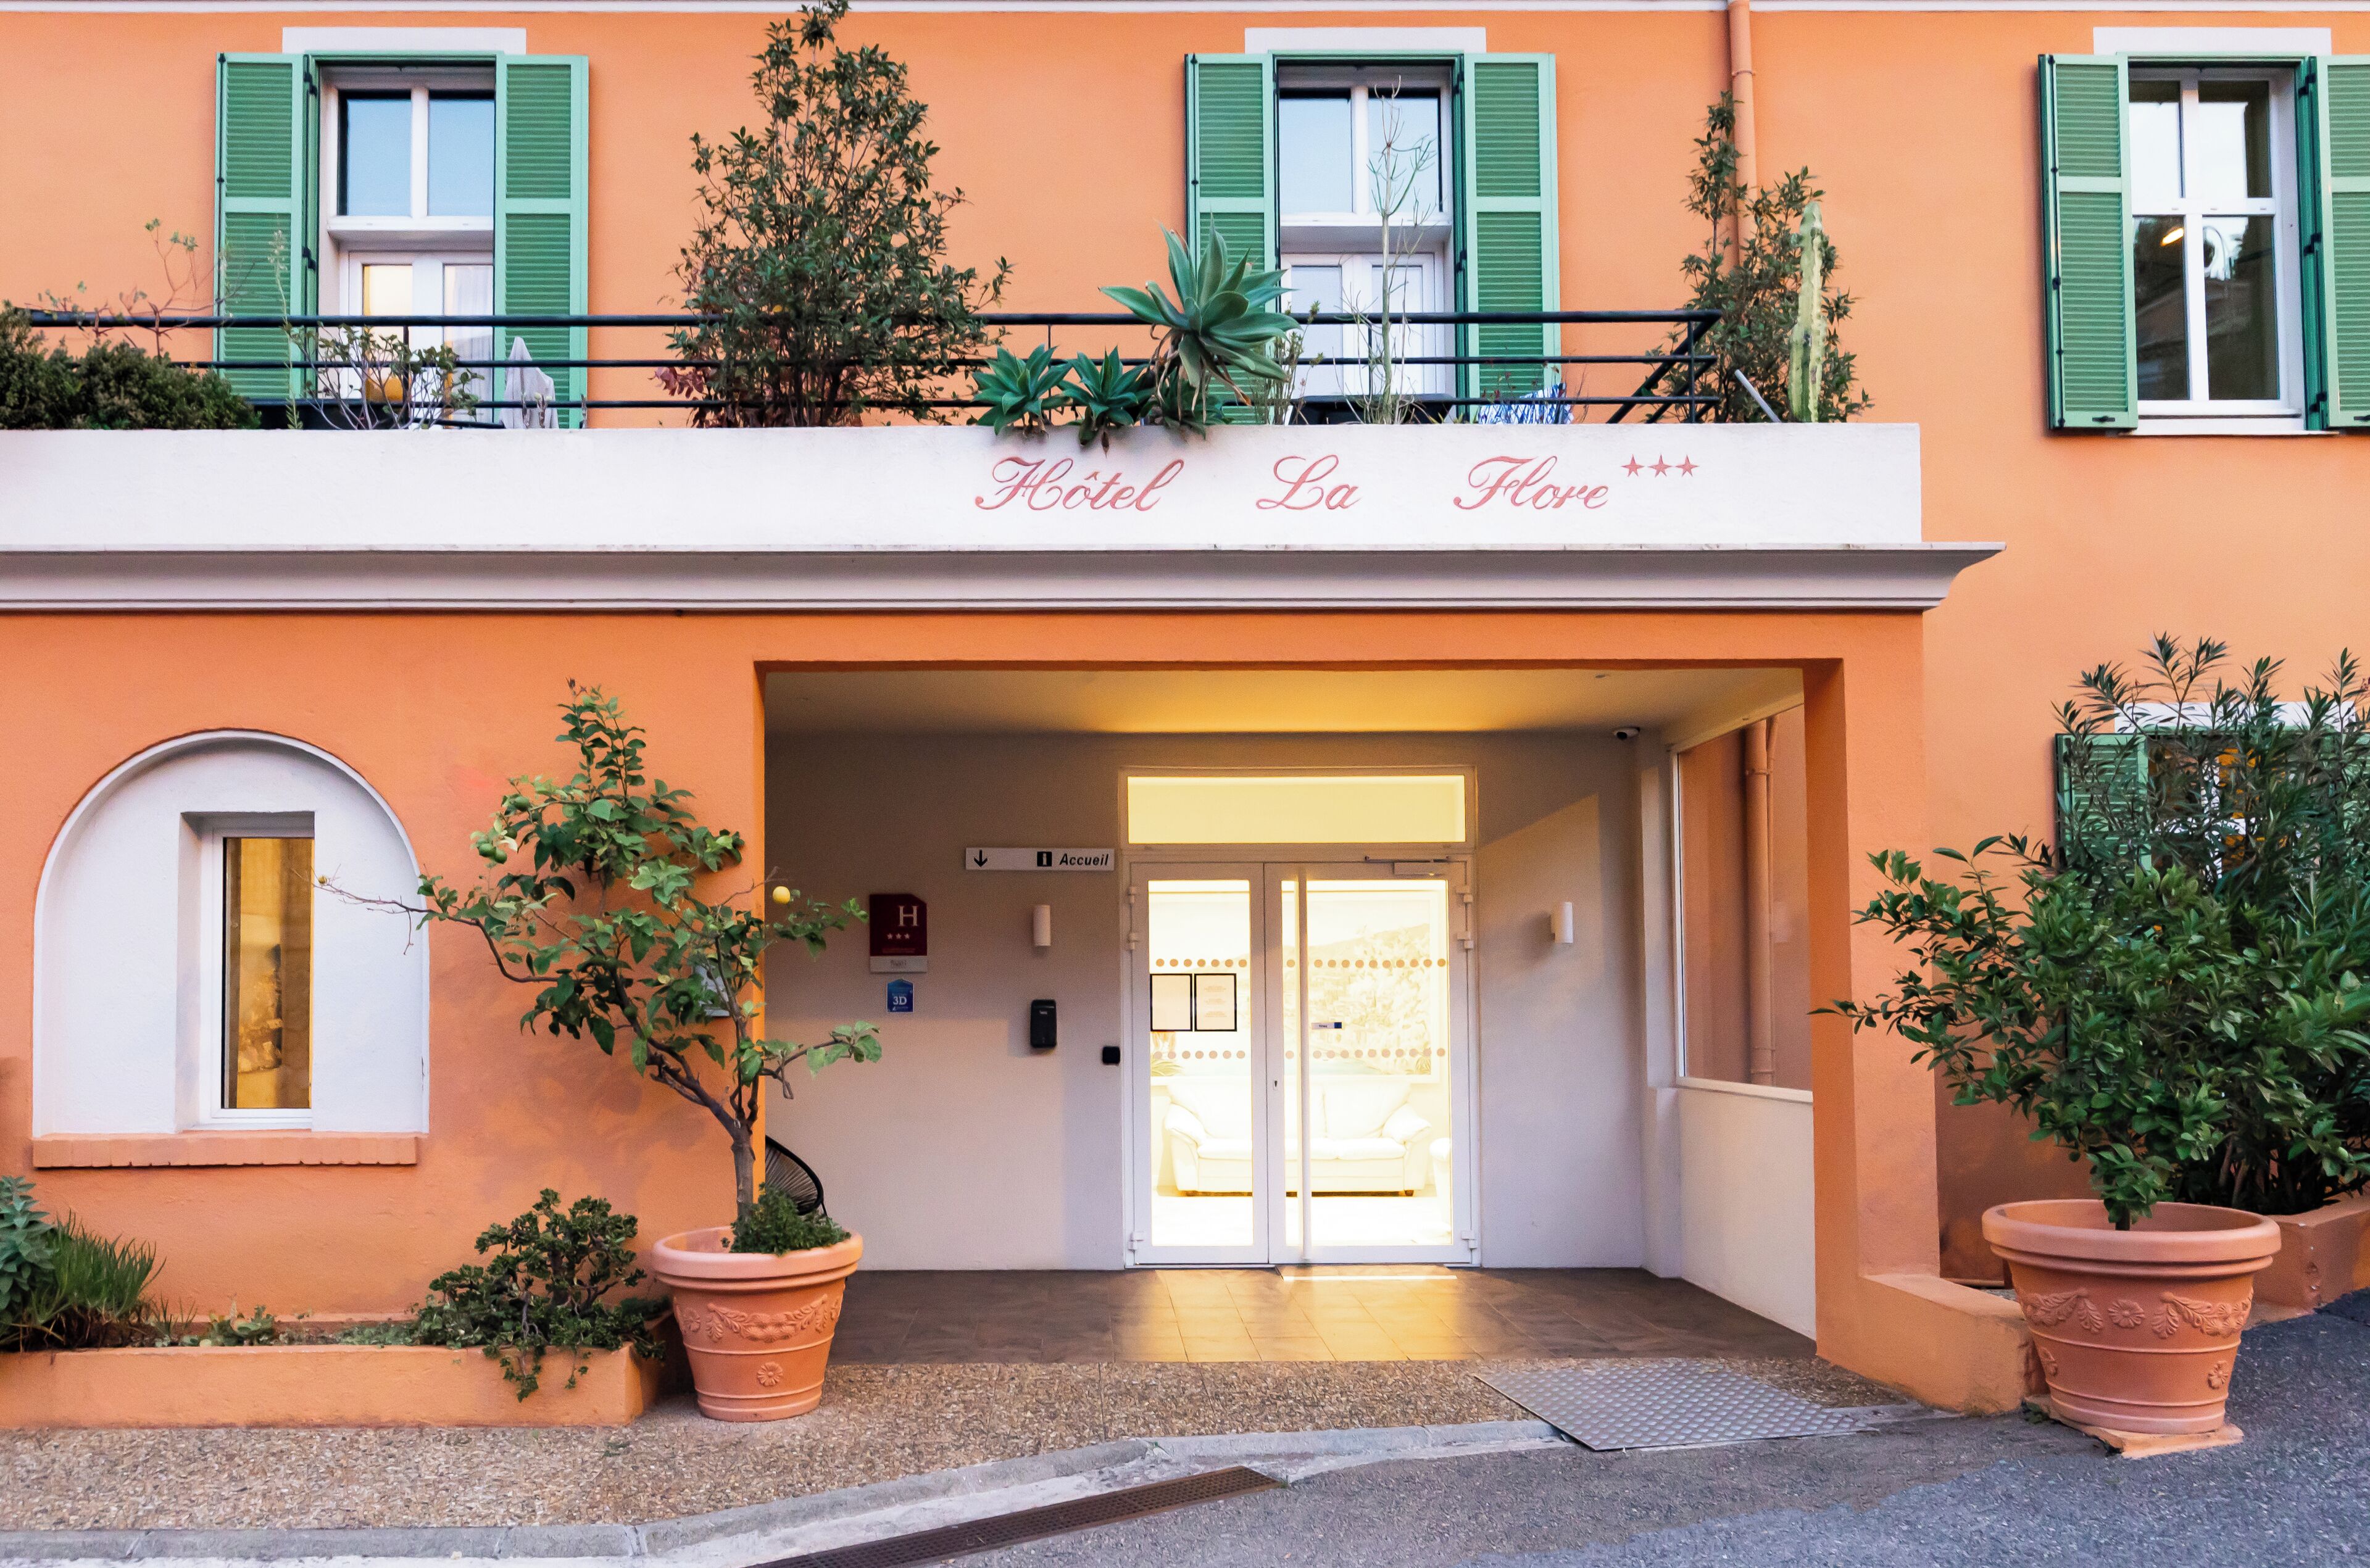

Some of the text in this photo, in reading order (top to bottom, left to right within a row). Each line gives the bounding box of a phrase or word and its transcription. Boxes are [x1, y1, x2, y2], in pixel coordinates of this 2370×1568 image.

[975, 454, 1608, 511] Hôtel La Flore
[1059, 853, 1109, 866] Accueil
[899, 905, 918, 926] H
[892, 996, 907, 1005] 3D
